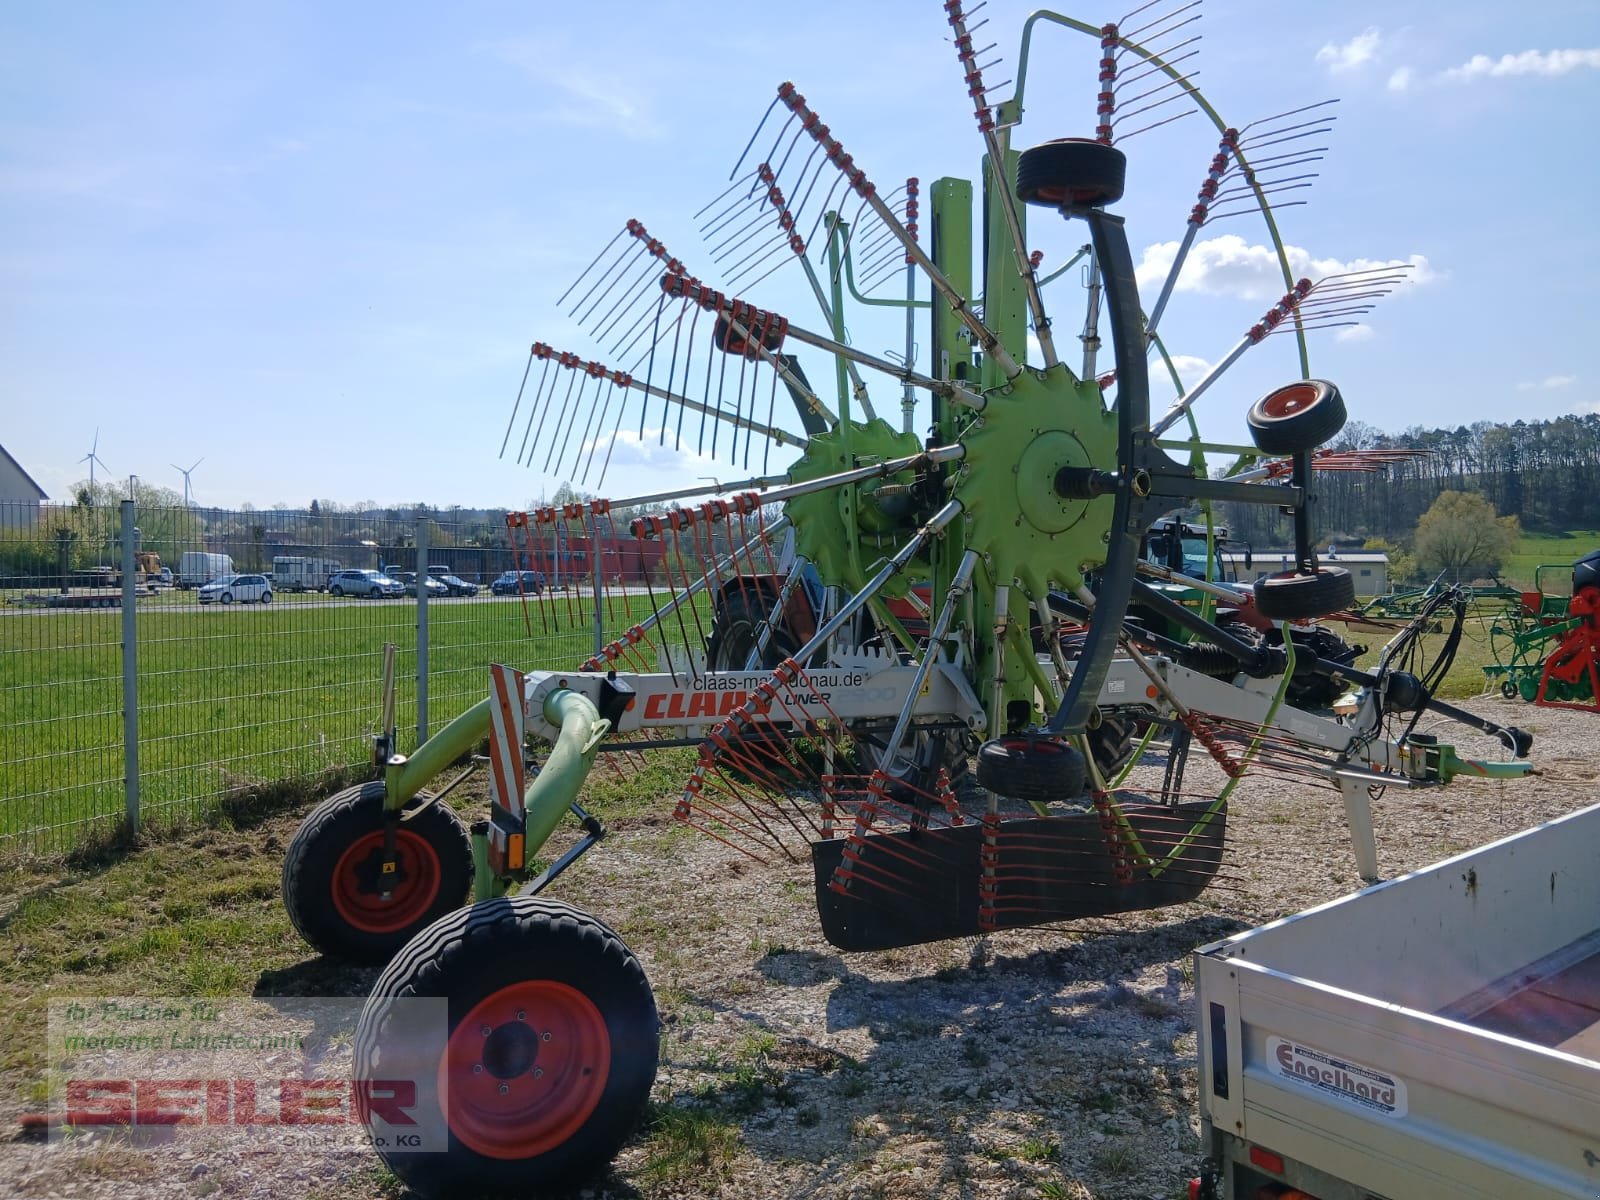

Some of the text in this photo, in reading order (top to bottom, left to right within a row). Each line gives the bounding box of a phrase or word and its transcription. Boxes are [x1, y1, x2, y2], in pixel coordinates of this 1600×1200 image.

[644, 691, 773, 719] CLAA
[785, 693, 831, 705] LINER
[1276, 1044, 1396, 1105] Engelhard
